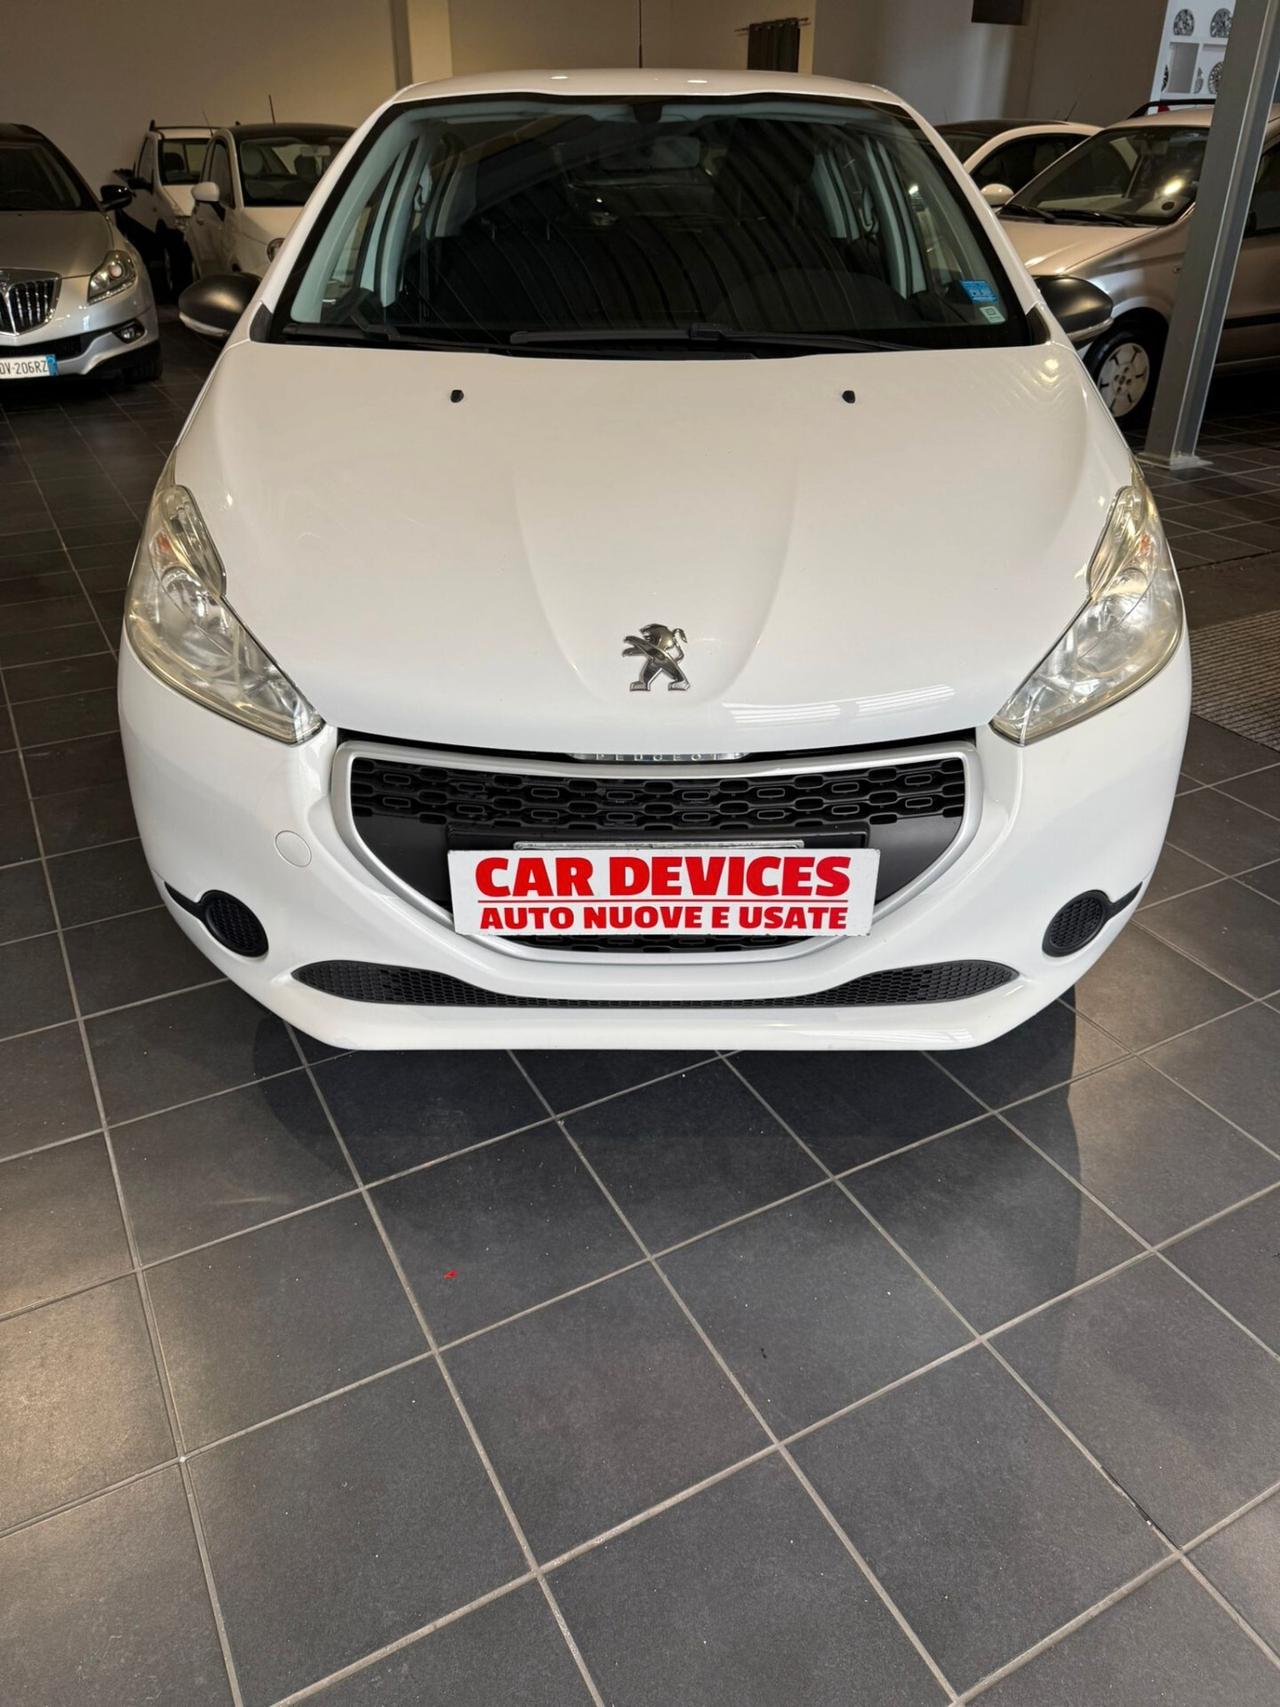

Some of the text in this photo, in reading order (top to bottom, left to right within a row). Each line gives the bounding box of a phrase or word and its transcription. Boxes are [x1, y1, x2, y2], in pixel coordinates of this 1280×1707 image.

[475, 856, 851, 898] CAR DEVICES
[480, 906, 848, 930] AUTO NUOVE E USATE
